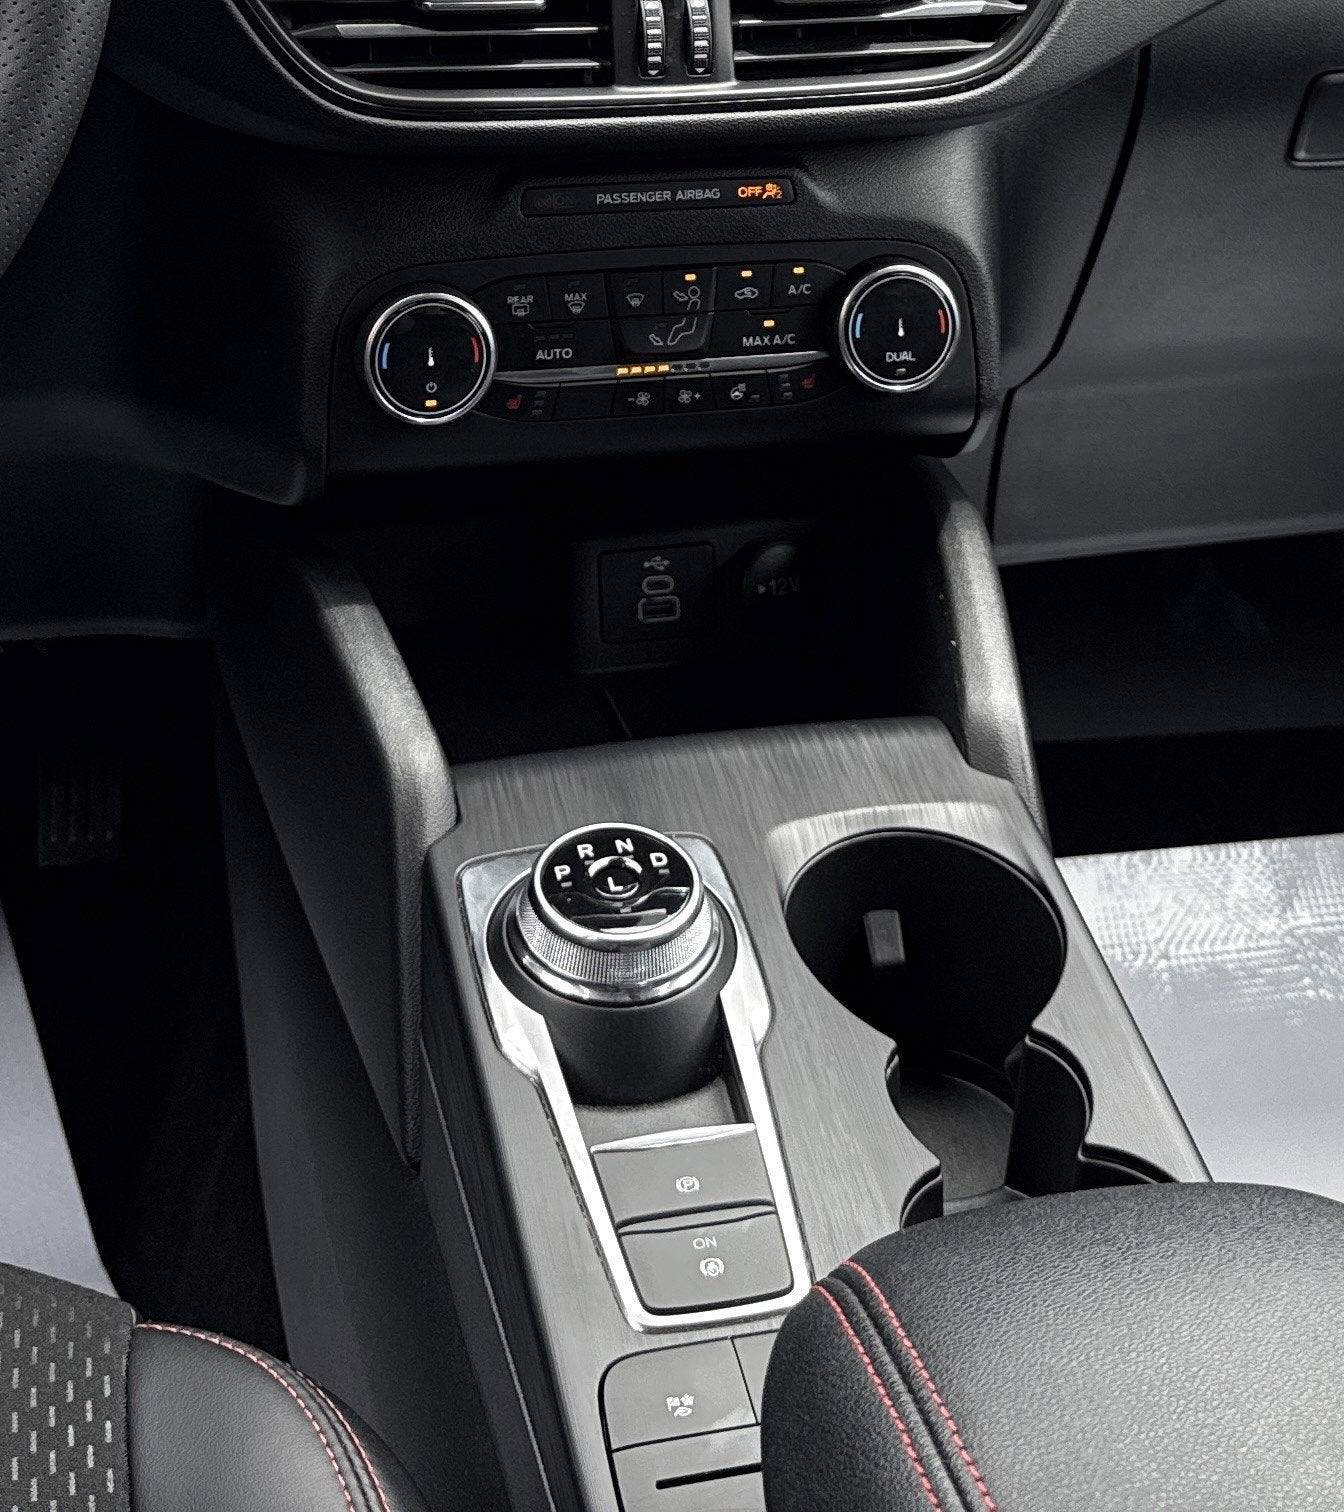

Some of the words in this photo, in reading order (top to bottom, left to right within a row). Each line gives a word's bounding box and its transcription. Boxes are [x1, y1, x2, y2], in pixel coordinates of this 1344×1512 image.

[596, 190, 672, 205] PASSENGER
[676, 187, 721, 201] AIRBAG
[737, 186, 763, 198] OFF
[787, 283, 812, 296] A/C
[506, 294, 534, 305] REAR
[564, 292, 588, 302] MAX
[742, 334, 771, 347] MAX
[773, 333, 796, 345] A/C
[535, 347, 573, 361] AUTO
[885, 350, 916, 363] DUAL
[576, 843, 595, 861] R
[614, 838, 634, 856] N
[649, 851, 668, 869] D
[553, 864, 572, 882] P
[607, 876, 624, 893] L
[692, 1235, 718, 1249] ON
